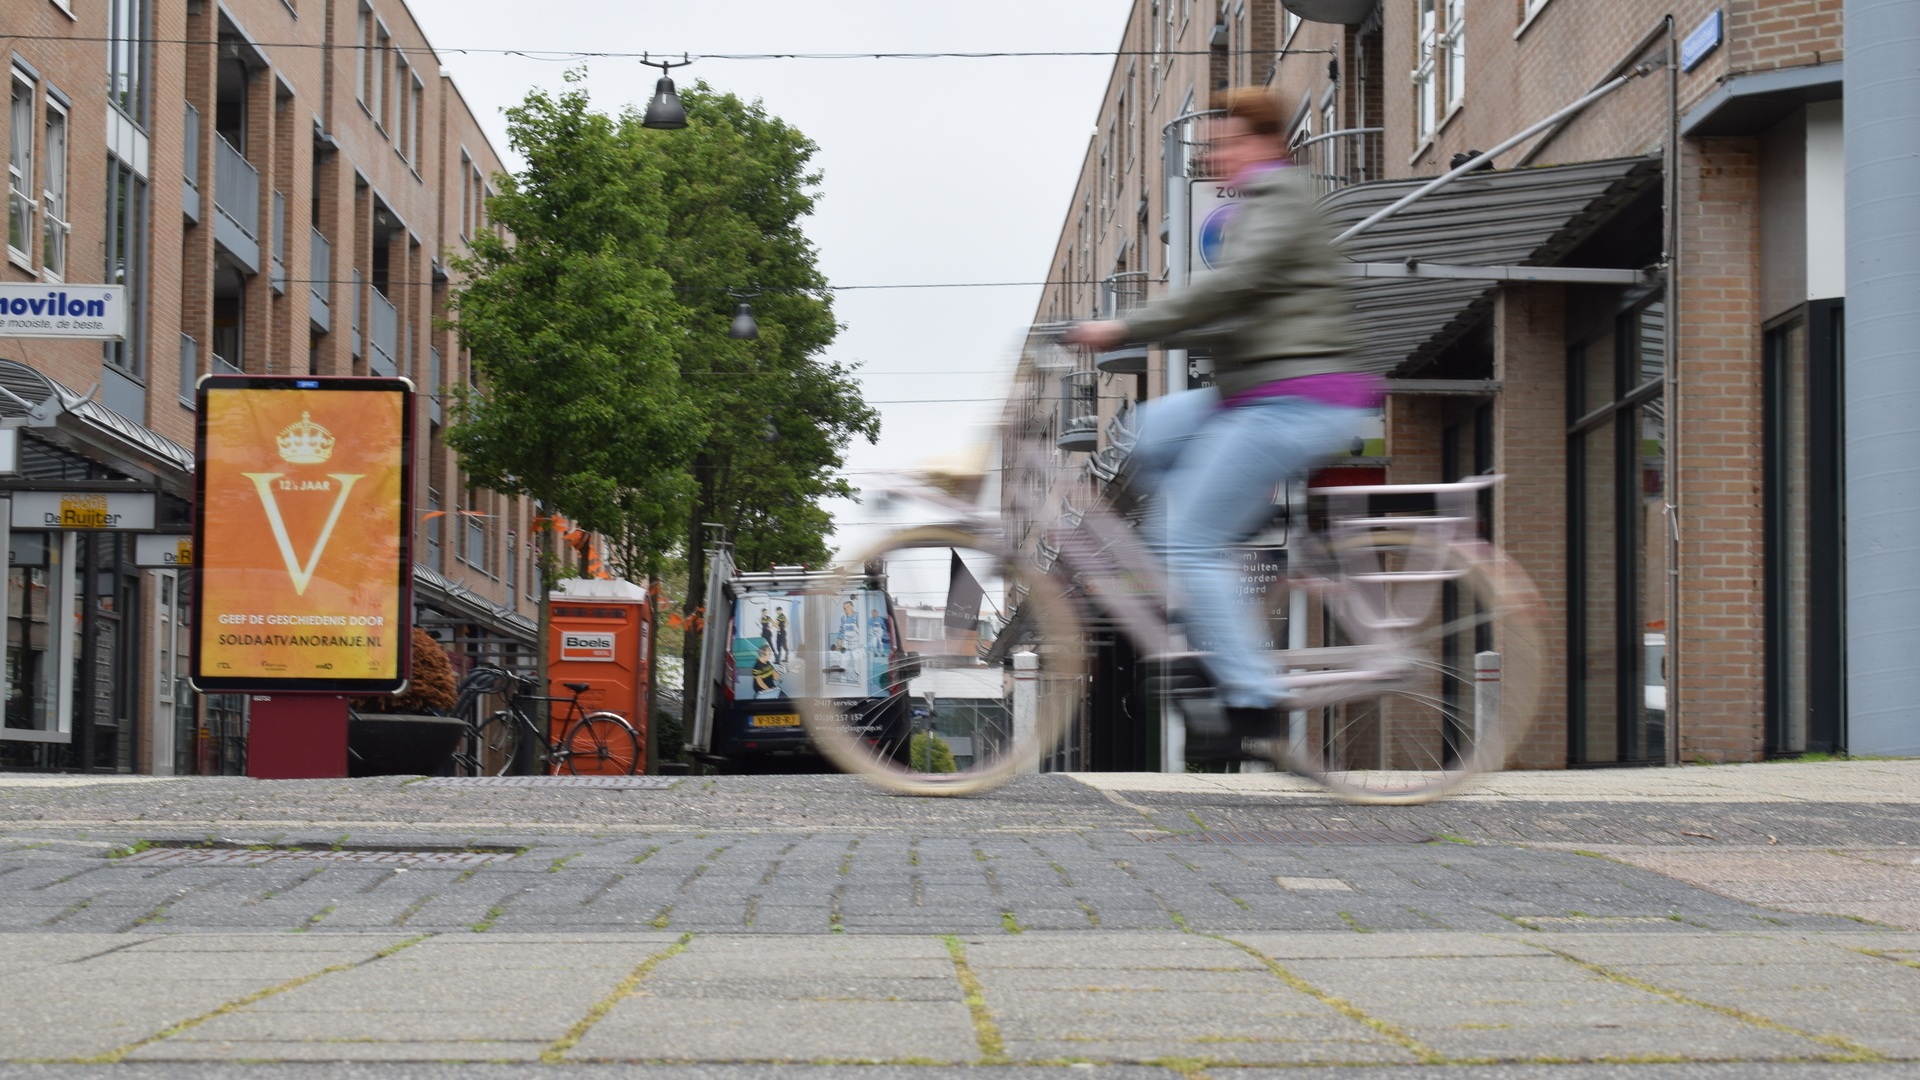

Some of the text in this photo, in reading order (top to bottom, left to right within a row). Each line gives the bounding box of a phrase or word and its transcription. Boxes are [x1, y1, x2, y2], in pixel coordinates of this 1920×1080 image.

[1216, 186, 1250, 199] ZON
[56, 320, 70, 329] de
[73, 320, 105, 330] beste.
[300, 480, 330, 491] JAAR
[44, 509, 122, 527] De Ruijter
[1243, 563, 1278, 572] buiten
[1240, 575, 1277, 583] worden
[218, 614, 384, 627] GEEF DE GESCHIEDENIS DOOR
[219, 634, 383, 648] SOLDAATVANORANJE.NL
[566, 637, 611, 648] Boels
